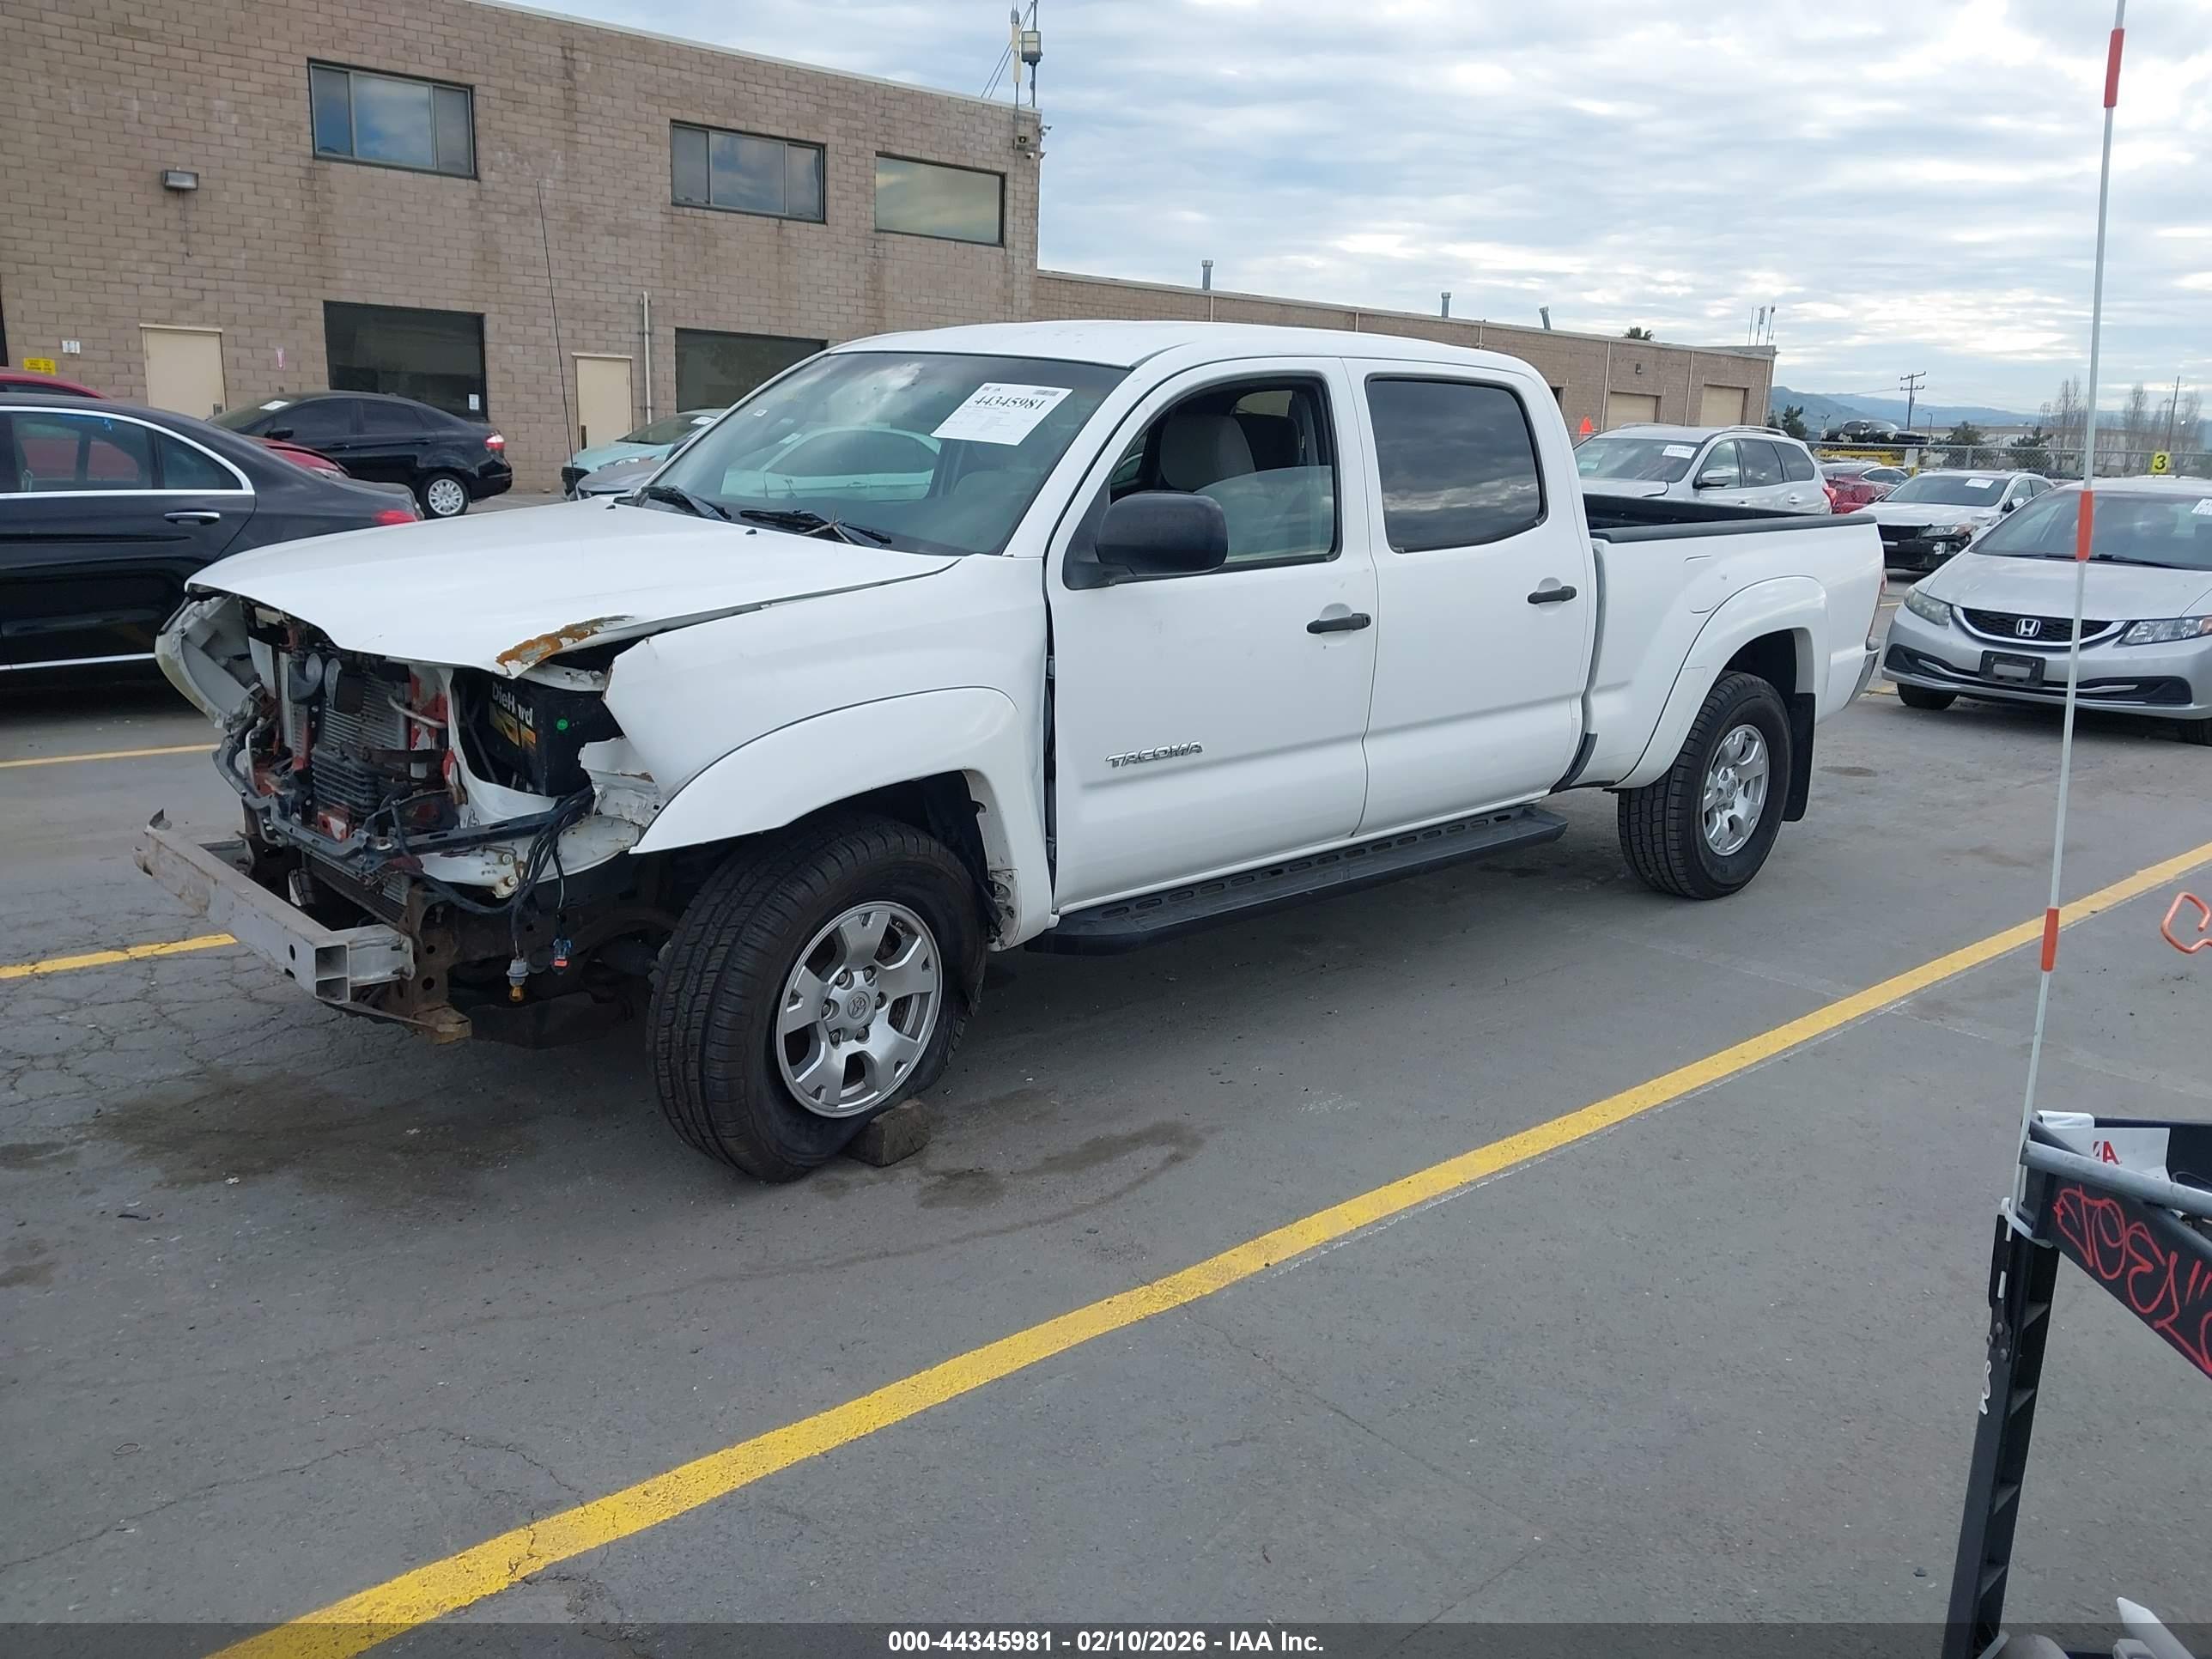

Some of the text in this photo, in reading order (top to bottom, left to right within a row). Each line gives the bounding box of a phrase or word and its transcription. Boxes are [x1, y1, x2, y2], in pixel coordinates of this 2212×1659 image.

[974, 395, 1046, 410] 44345981
[2154, 454, 2166, 470] 3
[1105, 741, 1203, 769] TACOMA
